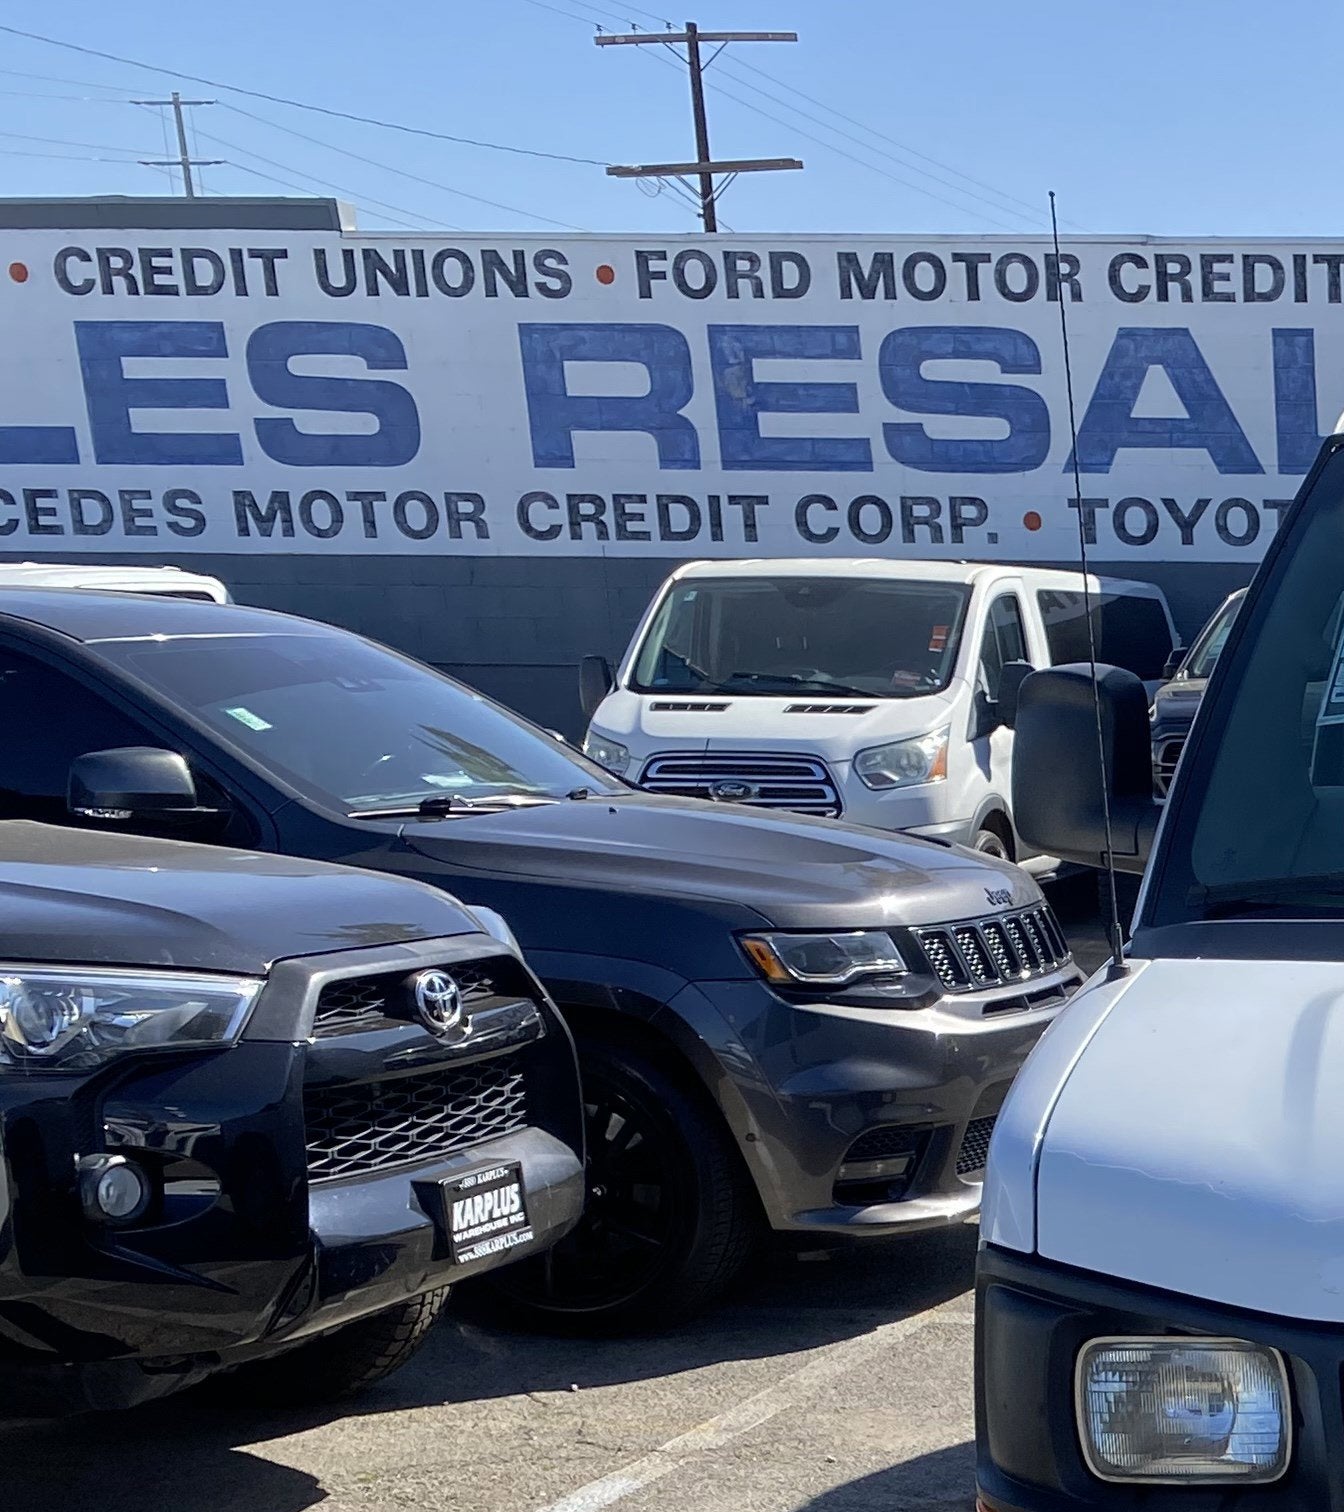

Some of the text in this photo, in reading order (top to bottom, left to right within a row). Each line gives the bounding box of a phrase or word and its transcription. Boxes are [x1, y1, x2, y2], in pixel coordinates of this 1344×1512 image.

[54, 247, 288, 297] CREDIT
[314, 248, 573, 299] UNIONS
[635, 249, 811, 300] FORD
[837, 250, 1083, 302] MOTOR
[233, 489, 490, 540] MOTOR
[516, 490, 770, 543] CREDIT
[799, 493, 999, 546] CORP.
[453, 1183, 520, 1232] KARPLUS
[453, 1211, 525, 1243] WAREHOUSE INC
